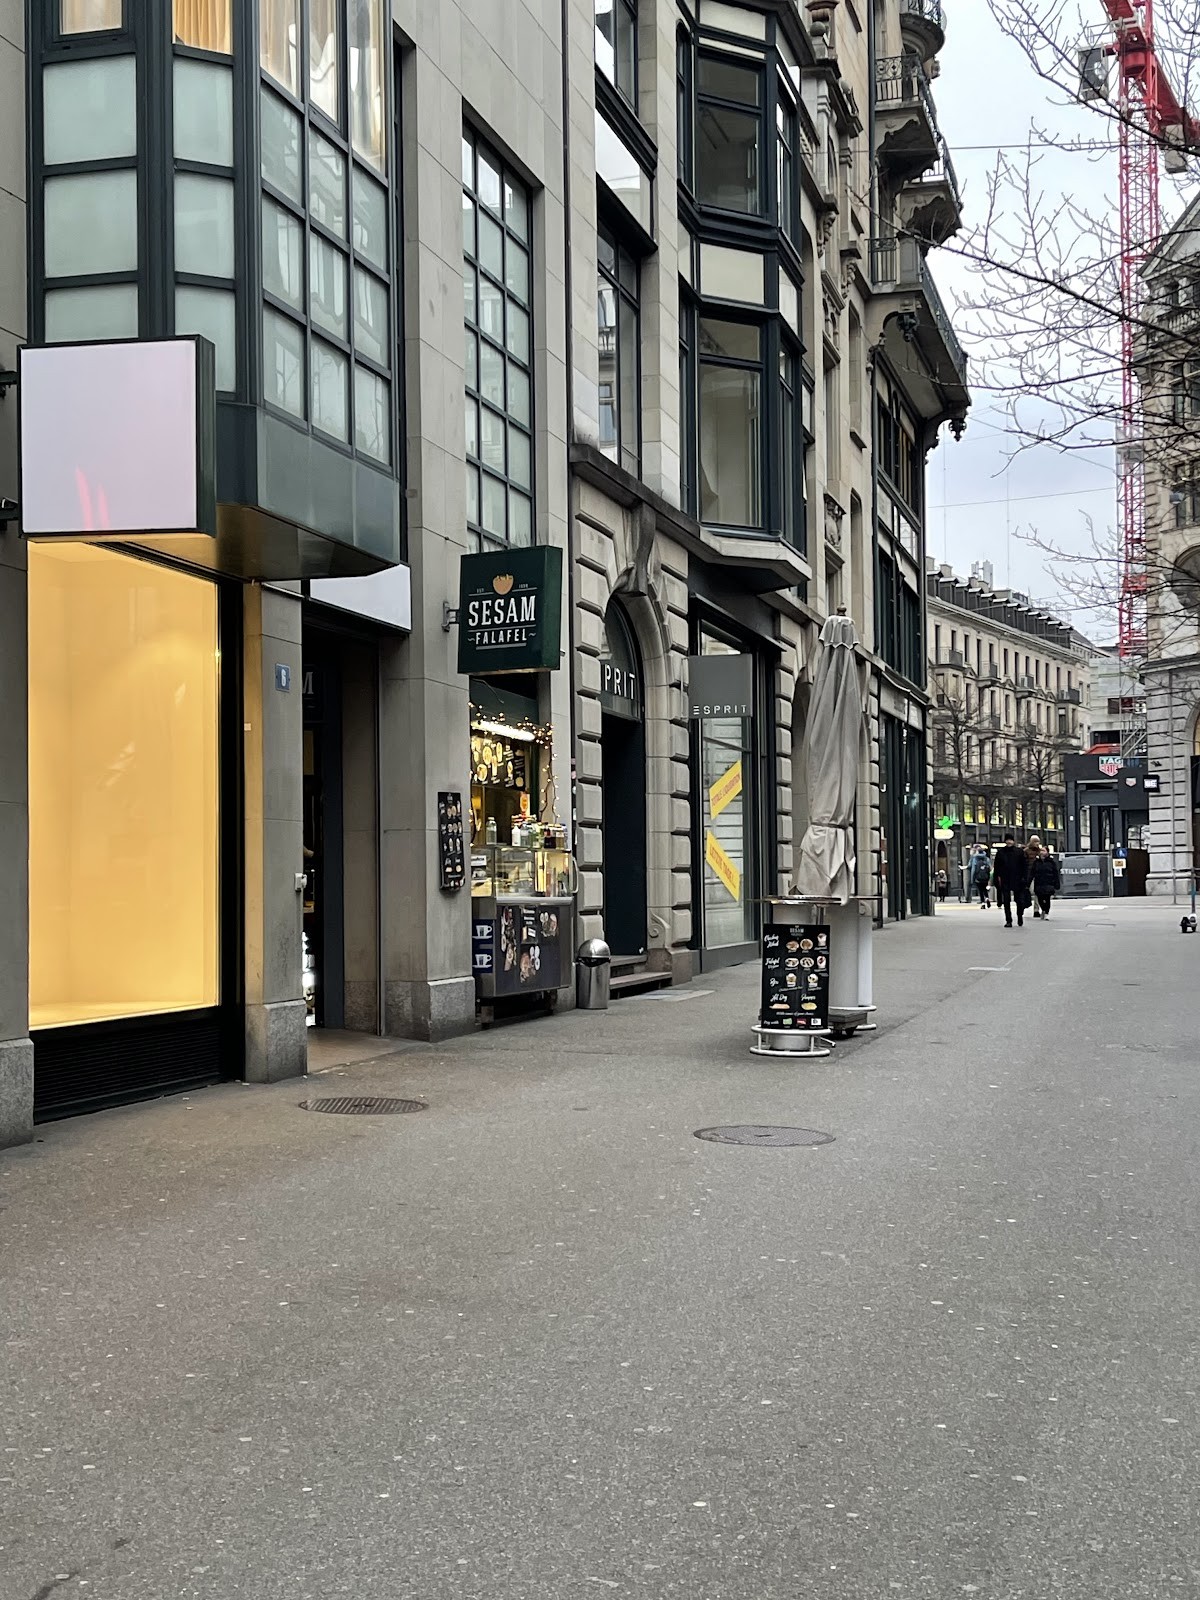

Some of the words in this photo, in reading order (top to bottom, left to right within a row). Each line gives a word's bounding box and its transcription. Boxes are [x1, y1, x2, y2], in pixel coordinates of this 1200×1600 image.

[468, 595, 536, 627] SESAM
[475, 628, 527, 645] FALAFEL
[281, 668, 287, 687] 6
[693, 704, 747, 715] ESPRIT
[1100, 757, 1123, 765] TAG
[1080, 867, 1101, 875] OPEN
